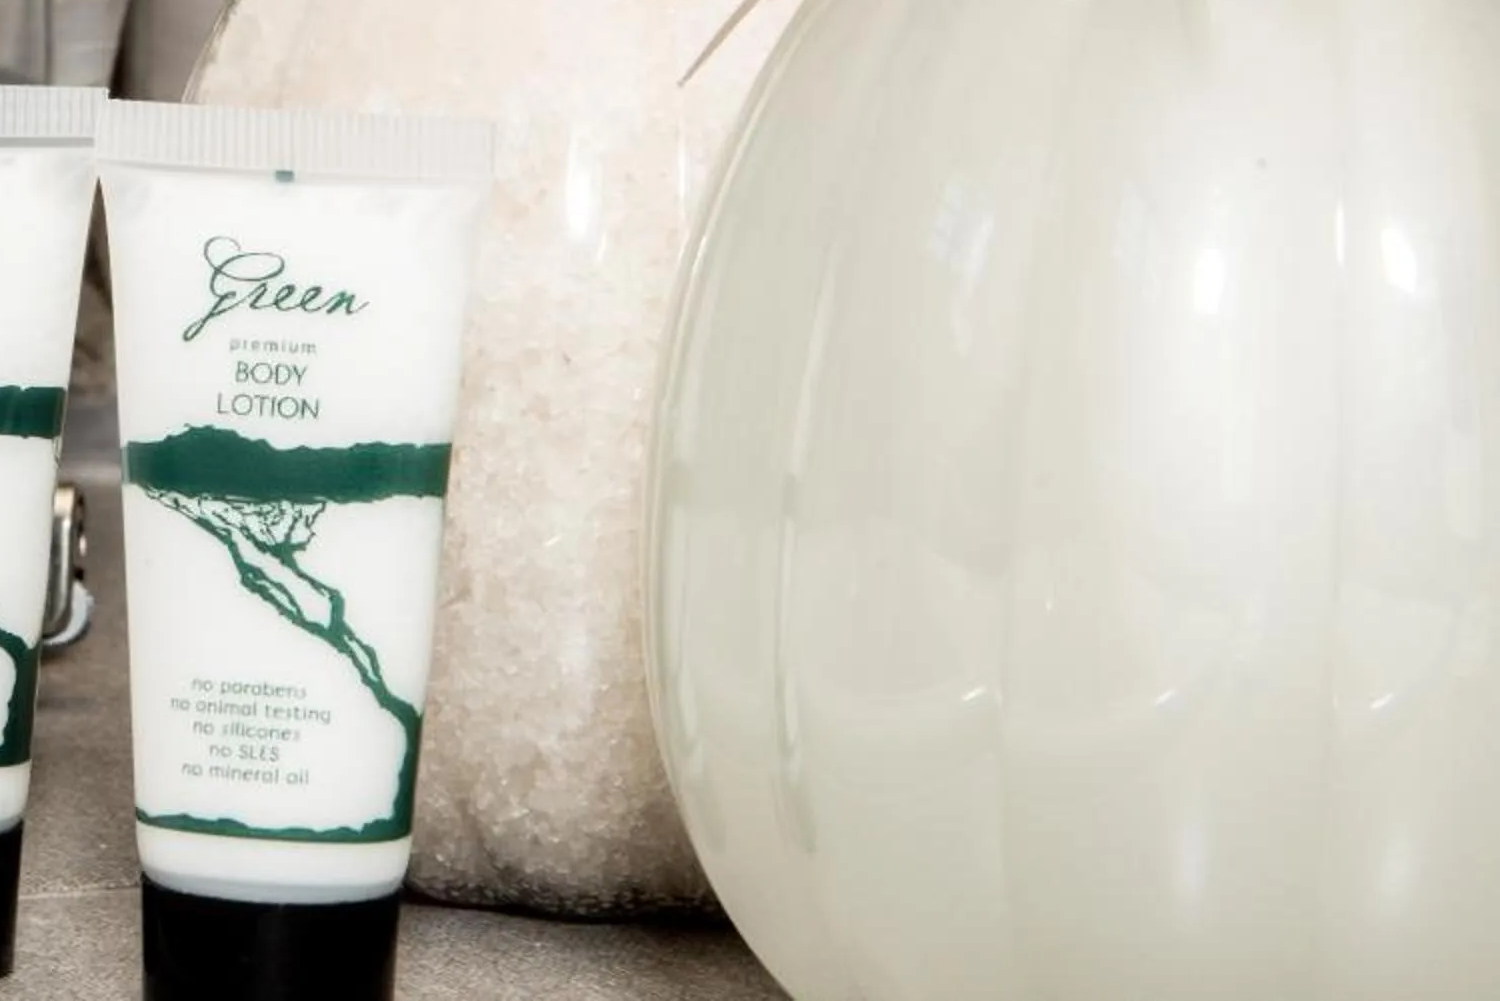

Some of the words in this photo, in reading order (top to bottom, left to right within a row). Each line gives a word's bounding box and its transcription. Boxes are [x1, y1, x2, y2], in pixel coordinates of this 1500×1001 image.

[183, 236, 370, 342] Green
[229, 338, 317, 354] premium
[235, 361, 308, 386] BODY
[217, 392, 320, 420] LOTION
[192, 678, 213, 692] no
[220, 680, 307, 700] parabens
[171, 697, 190, 711] no
[196, 700, 257, 717] animal
[265, 703, 331, 725] testing
[193, 720, 214, 736] no
[222, 722, 301, 742] silicones
[209, 744, 232, 758] no
[239, 744, 280, 762] SLES
[181, 763, 203, 777] no
[209, 764, 279, 785] mineral
[286, 769, 309, 785] oil
